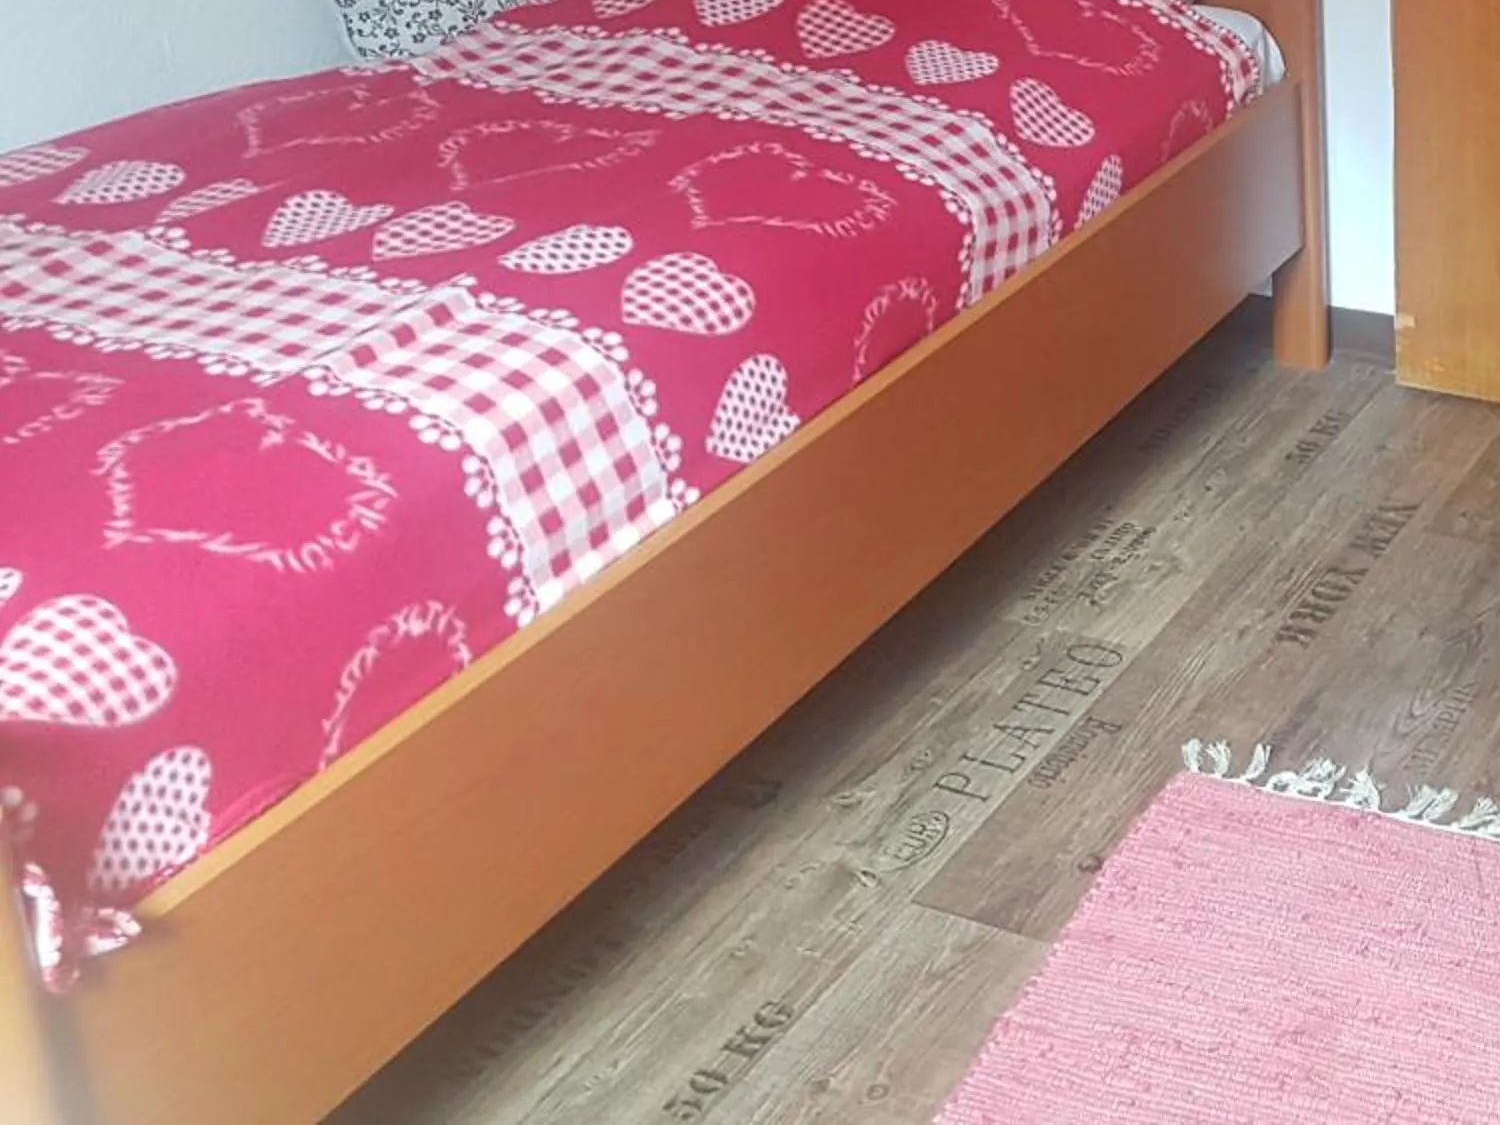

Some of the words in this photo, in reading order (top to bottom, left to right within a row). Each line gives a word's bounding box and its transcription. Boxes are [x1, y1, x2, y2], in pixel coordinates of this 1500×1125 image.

[1275, 567, 1370, 650] YORK
[931, 644, 1123, 803] PLATEO
[661, 1067, 729, 1121] 50
[720, 999, 796, 1058] KG
